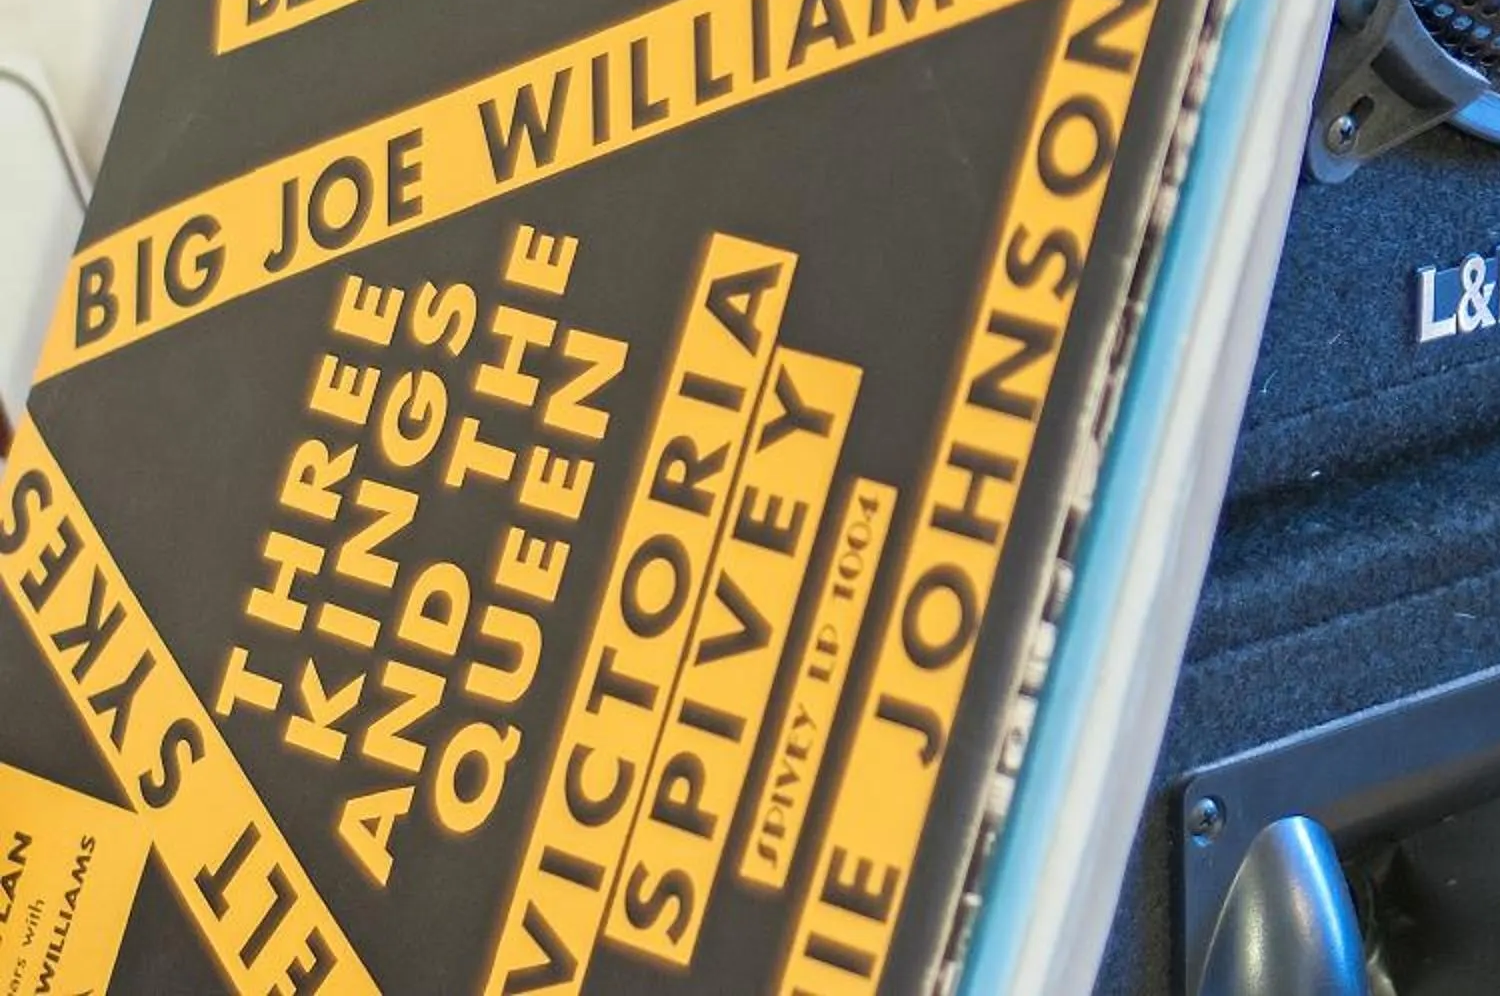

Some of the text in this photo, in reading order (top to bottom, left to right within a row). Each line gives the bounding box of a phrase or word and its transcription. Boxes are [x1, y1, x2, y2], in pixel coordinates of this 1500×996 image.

[73, 213, 226, 350] BIG
[263, 127, 424, 274] JOE
[0, 469, 206, 809] SYKES
[215, 274, 405, 717] THREE
[284, 280, 477, 761] KINGS
[336, 225, 579, 887] AND THE
[433, 328, 629, 835] QUEEN
[503, 262, 784, 996] VICTORIA
[624, 358, 837, 946] SPIVEY
[757, 702, 817, 870] SPIVEY
[832, 493, 882, 602] 1004
[22, 898, 46, 947] with
[35, 834, 96, 995] WILLIAMS
[793, 844, 901, 996] IE
